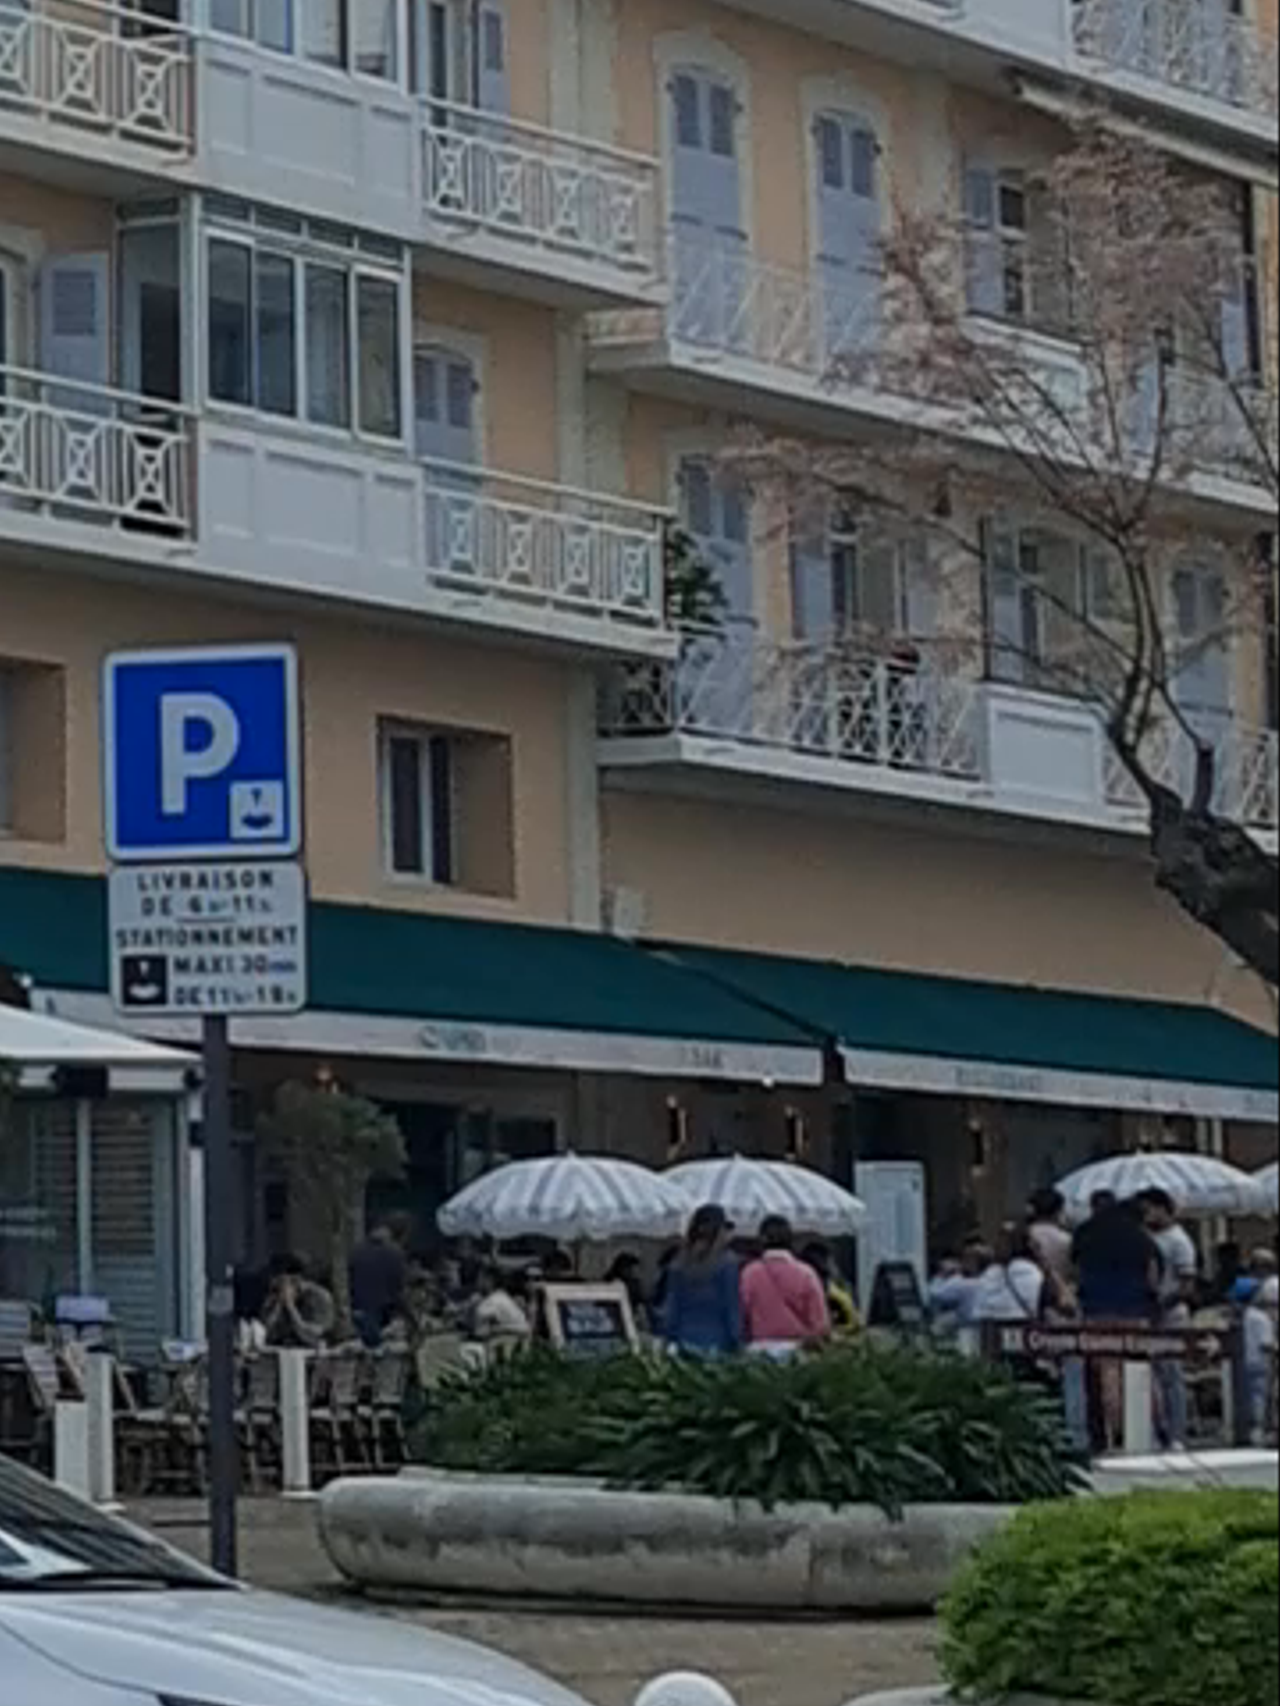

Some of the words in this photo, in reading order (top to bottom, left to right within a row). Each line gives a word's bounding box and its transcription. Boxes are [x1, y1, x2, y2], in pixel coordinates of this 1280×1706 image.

[160, 693, 240, 815] P
[137, 870, 274, 891] LIVRAISON
[141, 897, 172, 916] DE
[116, 925, 298, 948] STATIONNEMENT
[173, 955, 234, 974] MAXI
[175, 987, 203, 1005] DE
